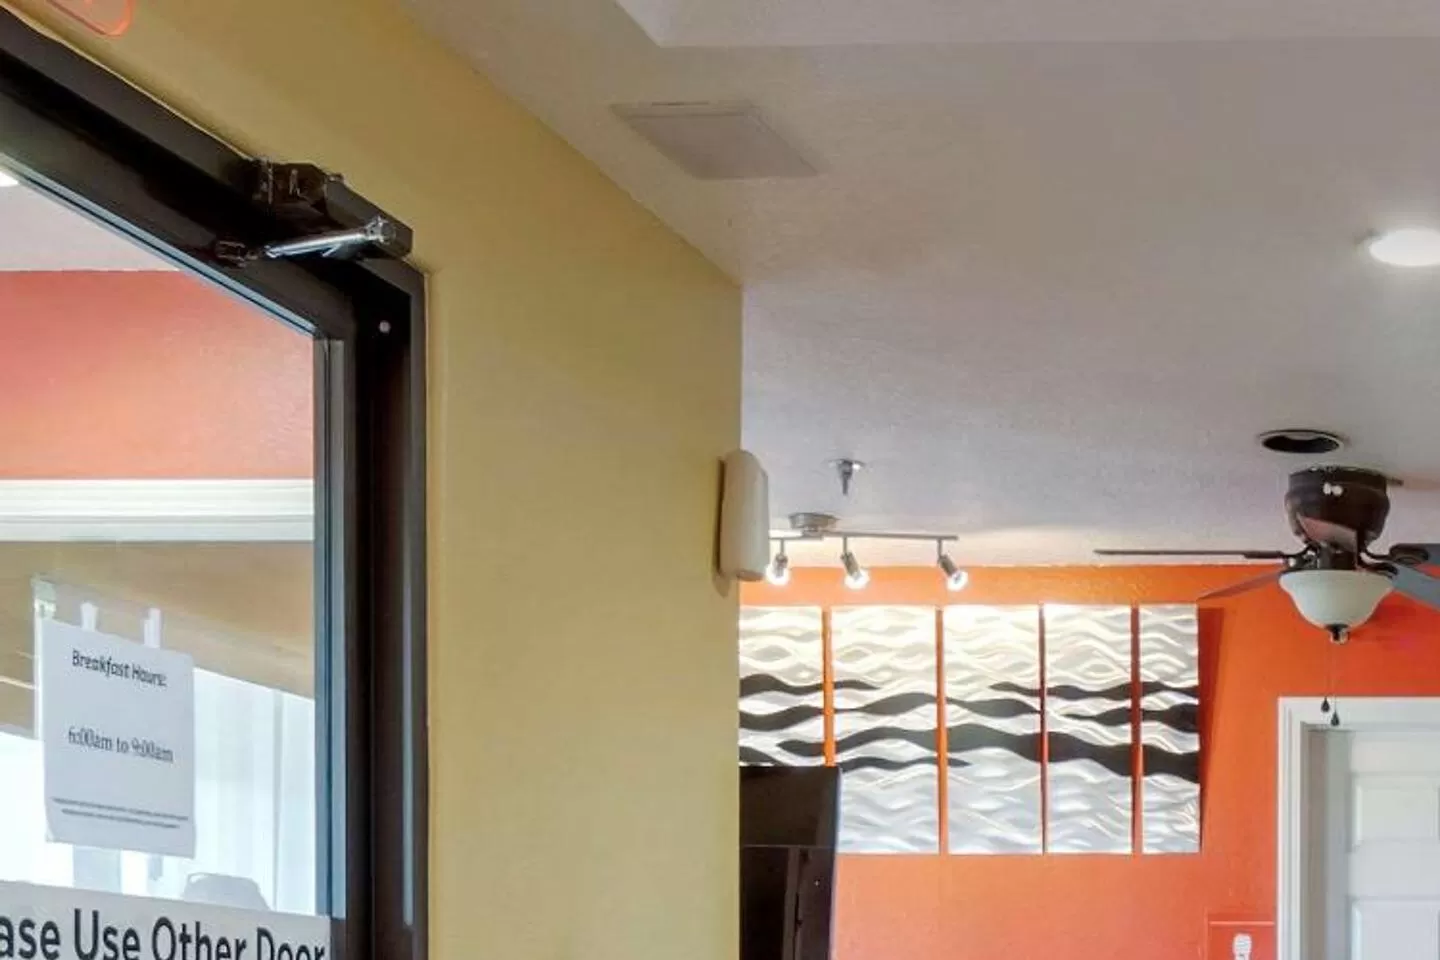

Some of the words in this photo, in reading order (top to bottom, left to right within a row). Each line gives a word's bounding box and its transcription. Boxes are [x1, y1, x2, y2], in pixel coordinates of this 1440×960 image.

[72, 648, 129, 678] Breakfast
[132, 664, 167, 687] Hours:
[68, 726, 112, 752] 6:00am
[116, 738, 129, 754] to
